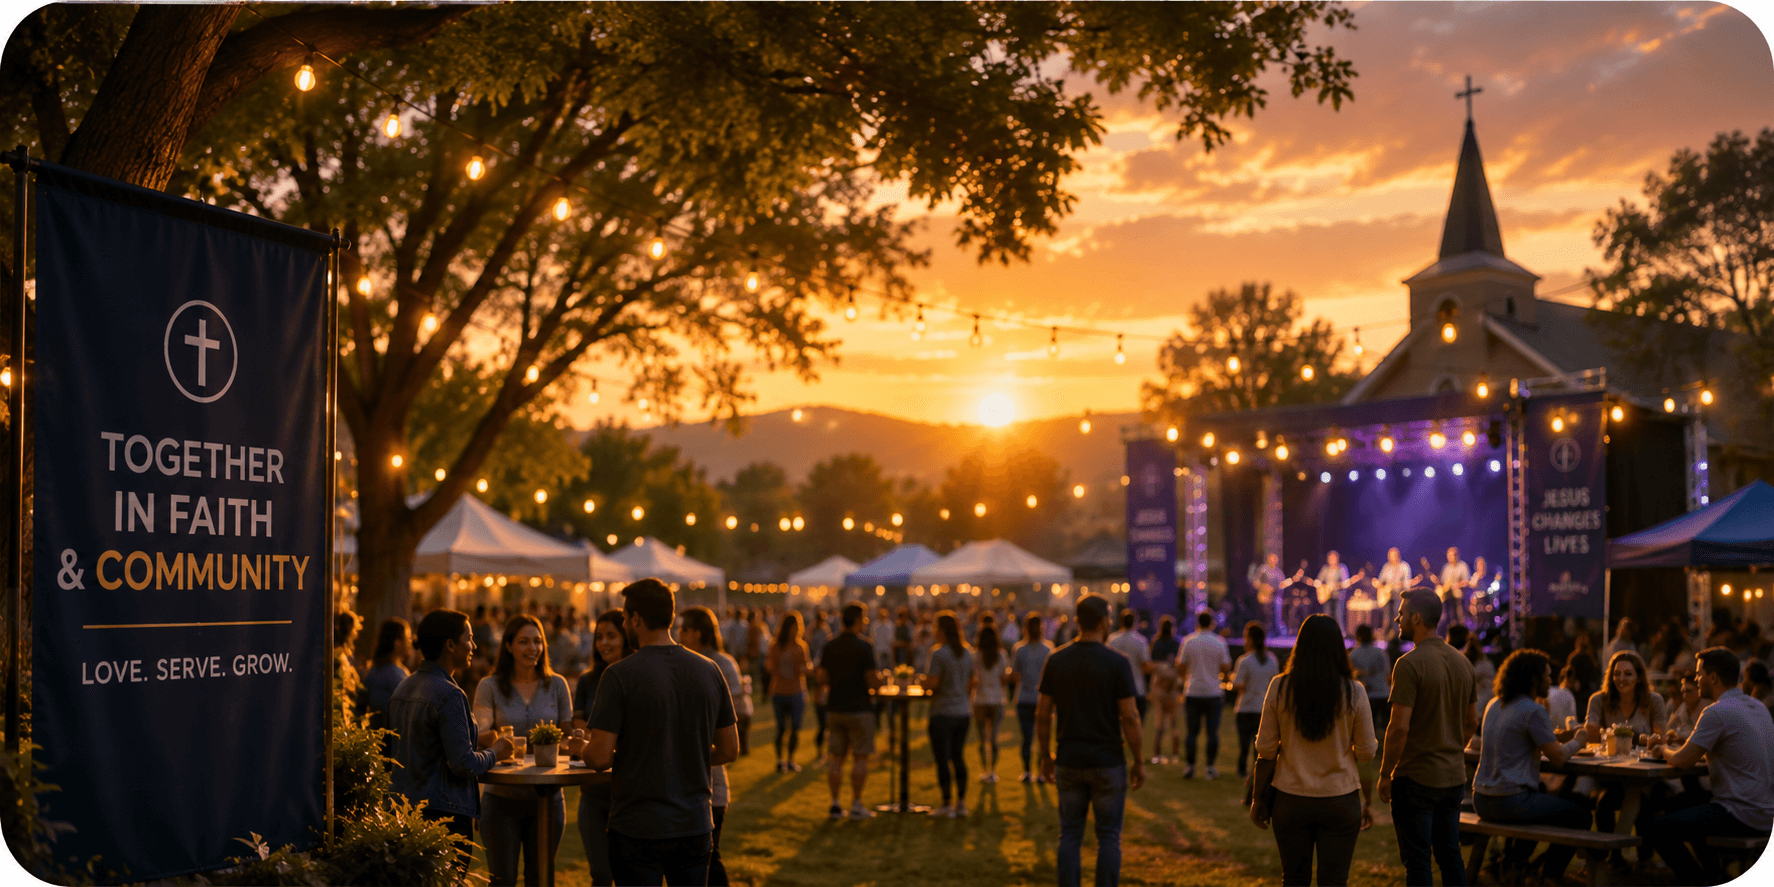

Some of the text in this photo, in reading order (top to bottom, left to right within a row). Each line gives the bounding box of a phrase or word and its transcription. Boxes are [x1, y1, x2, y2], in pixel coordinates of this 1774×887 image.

[101, 431, 284, 484] TOGETHER
[115, 490, 272, 537] IN FAITH
[1543, 487, 1590, 508] JESUS
[1532, 510, 1601, 531] CHANGES
[1544, 534, 1590, 554] LIVES
[57, 548, 310, 591] & COMMUNITY
[82, 653, 293, 685] LOVE. SERVE. GROW.
